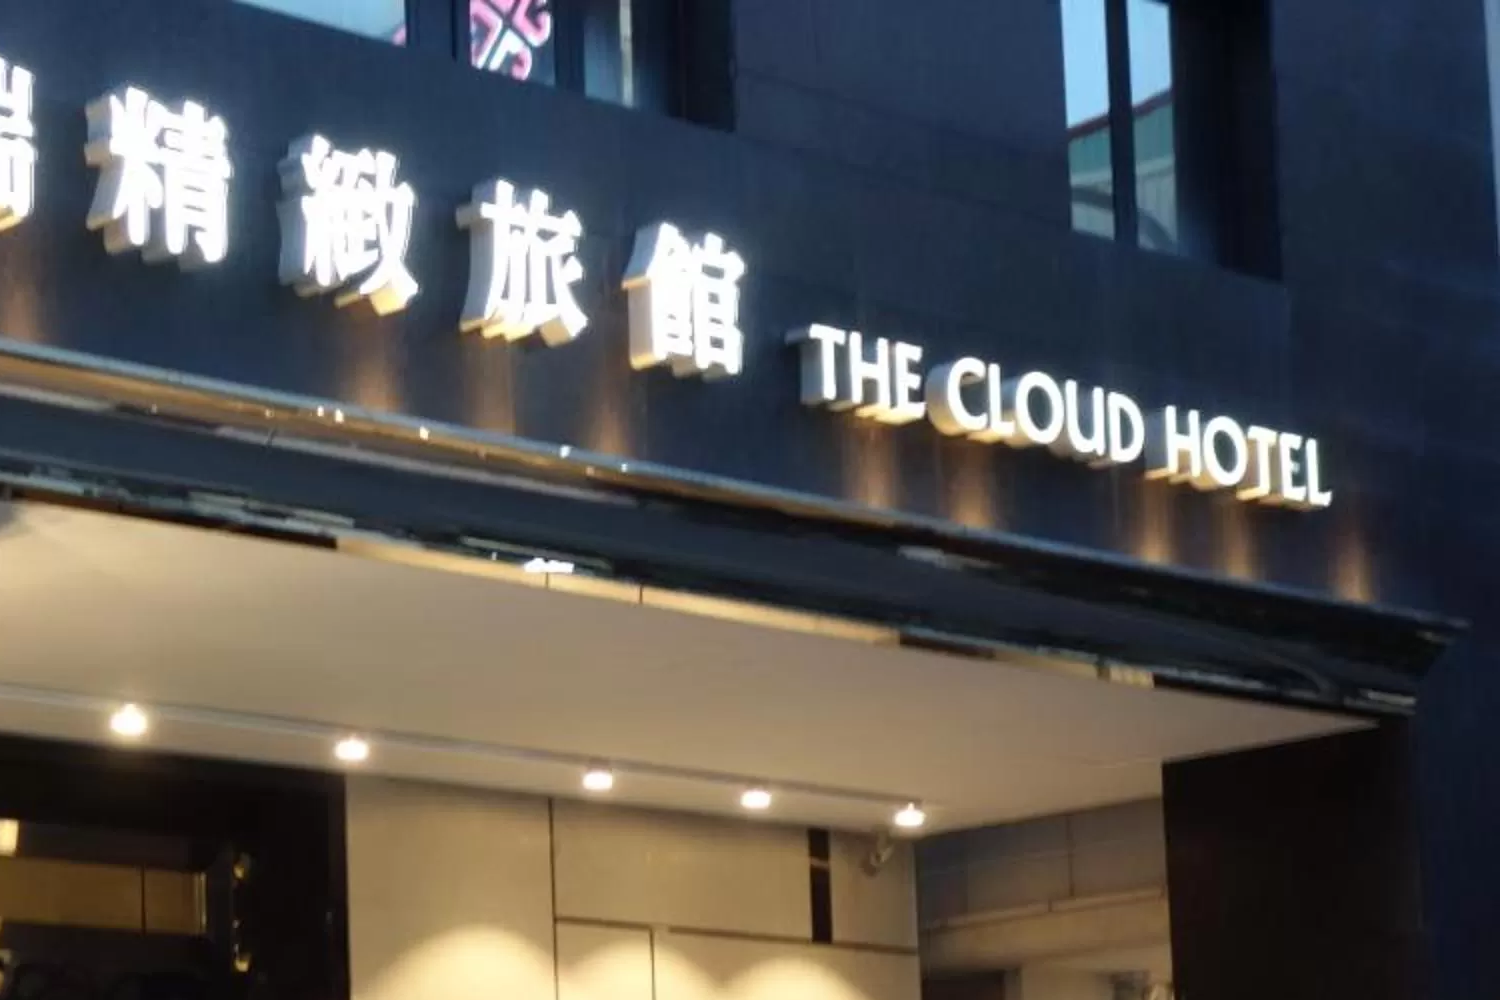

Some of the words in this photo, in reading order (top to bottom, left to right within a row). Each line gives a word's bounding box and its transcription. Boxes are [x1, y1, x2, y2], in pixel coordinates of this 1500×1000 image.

[803, 322, 927, 420] THE
[944, 355, 1146, 464] CLOUD
[1160, 403, 1334, 508] HOTEL
